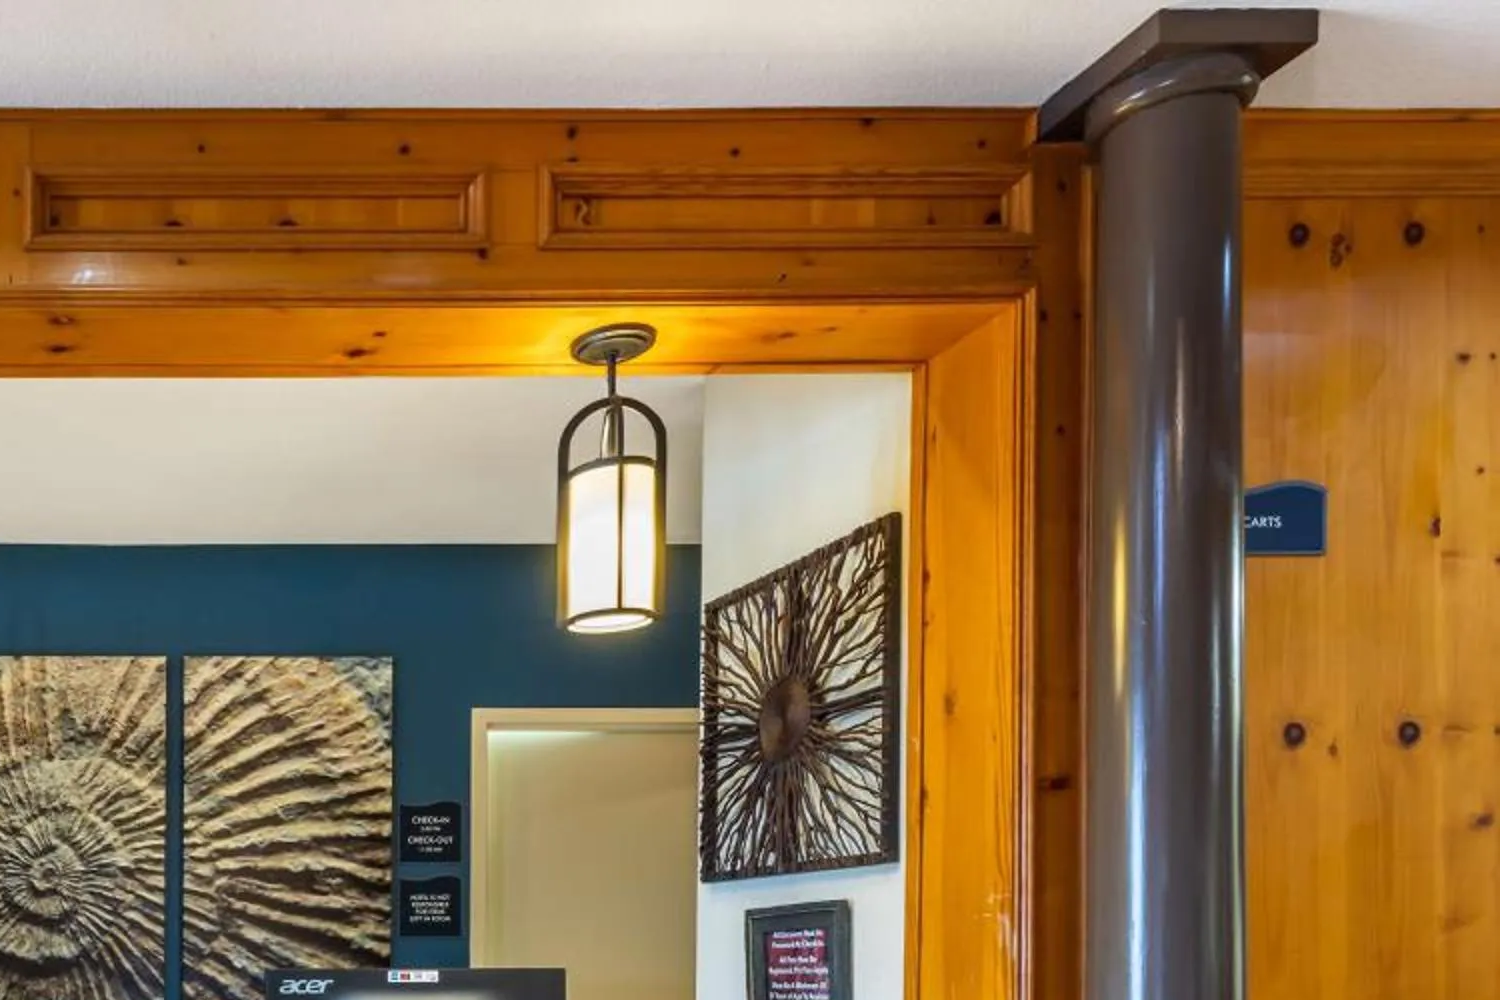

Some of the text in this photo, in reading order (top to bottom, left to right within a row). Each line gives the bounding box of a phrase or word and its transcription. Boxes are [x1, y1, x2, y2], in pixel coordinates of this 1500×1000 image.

[411, 816, 450, 824] CHECK-IN
[407, 836, 453, 844] CHECK-OUT
[279, 979, 335, 994] acer
